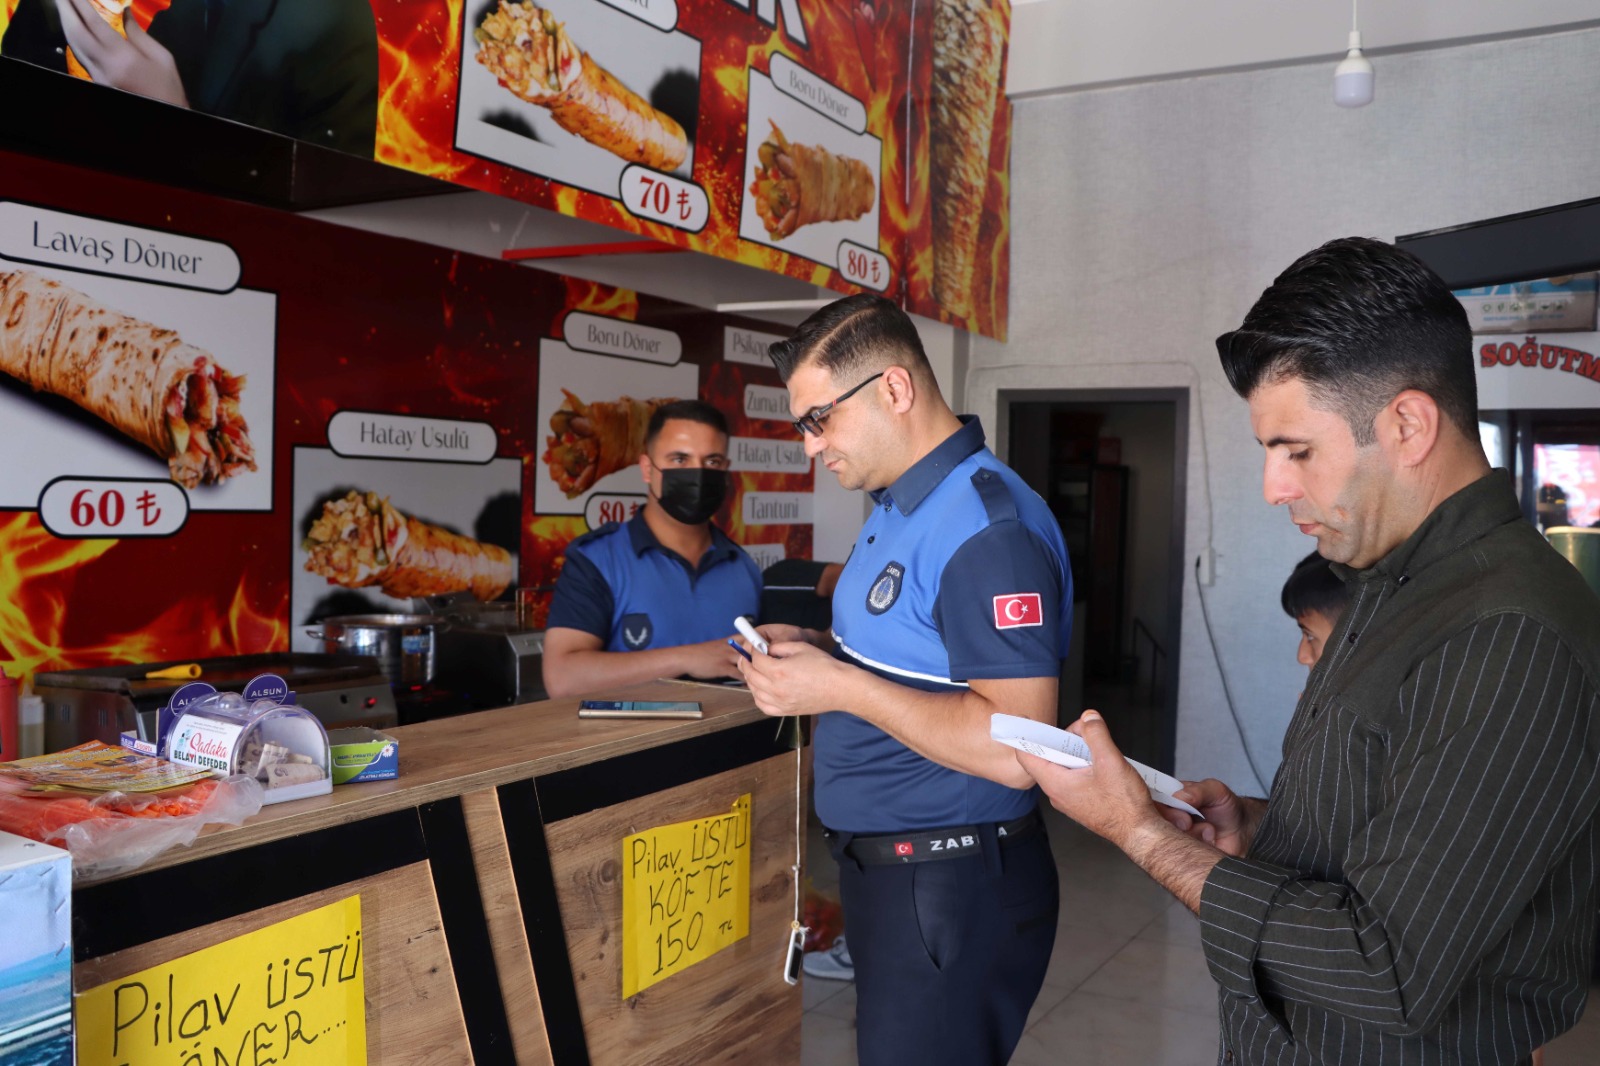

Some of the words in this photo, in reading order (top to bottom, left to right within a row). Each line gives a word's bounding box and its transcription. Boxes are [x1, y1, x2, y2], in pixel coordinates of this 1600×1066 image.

[789, 69, 815, 100] Boru
[818, 87, 849, 118] Döner
[640, 175, 670, 214] 70
[677, 188, 692, 220] ₺
[33, 221, 114, 264] Lavaş
[124, 238, 203, 274] Döner
[848, 249, 867, 279] 80
[587, 324, 620, 347] Boru
[623, 331, 661, 353] Döner
[733, 332, 769, 362] Psikop
[361, 421, 415, 451] Hatay
[421, 426, 470, 449] Usulü
[738, 443, 772, 469] Hatay
[70, 488, 125, 527] 60
[136, 490, 161, 526] ₺
[599, 500, 625, 525] 80
[749, 496, 800, 519] Tantuni
[251, 688, 282, 698] ALSUN
[190, 732, 228, 760] Sadaka
[198, 755, 228, 772] DEFEDER
[632, 837, 682, 879] Pilav
[691, 803, 748, 863] ÜSTÜ
[650, 859, 734, 926] KÖFTE
[653, 911, 704, 976] 150
[113, 974, 241, 1057] Pilav
[267, 930, 361, 1009] ÜSTÜ
